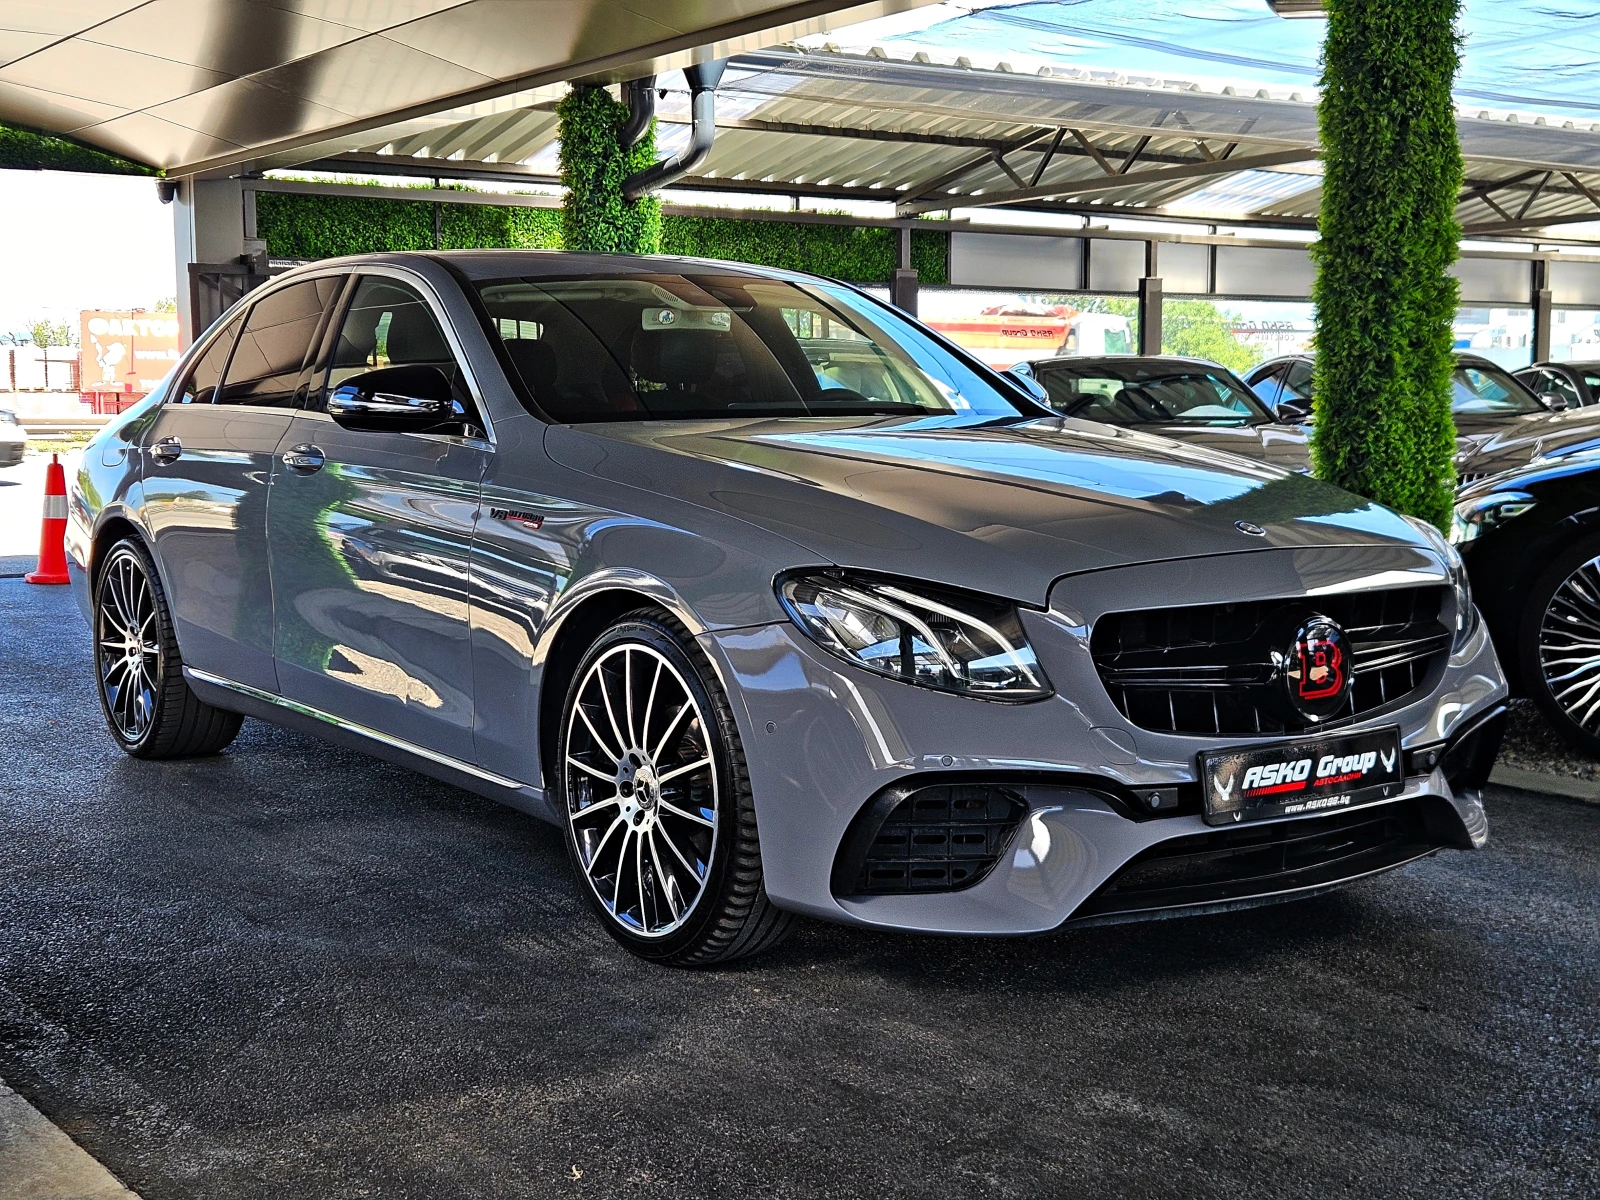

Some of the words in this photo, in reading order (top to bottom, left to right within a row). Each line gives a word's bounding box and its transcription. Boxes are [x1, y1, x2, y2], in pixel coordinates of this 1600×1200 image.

[1298, 641, 1343, 700] B
[1241, 759, 1312, 790] ASKO
[1316, 751, 1377, 777] Group
